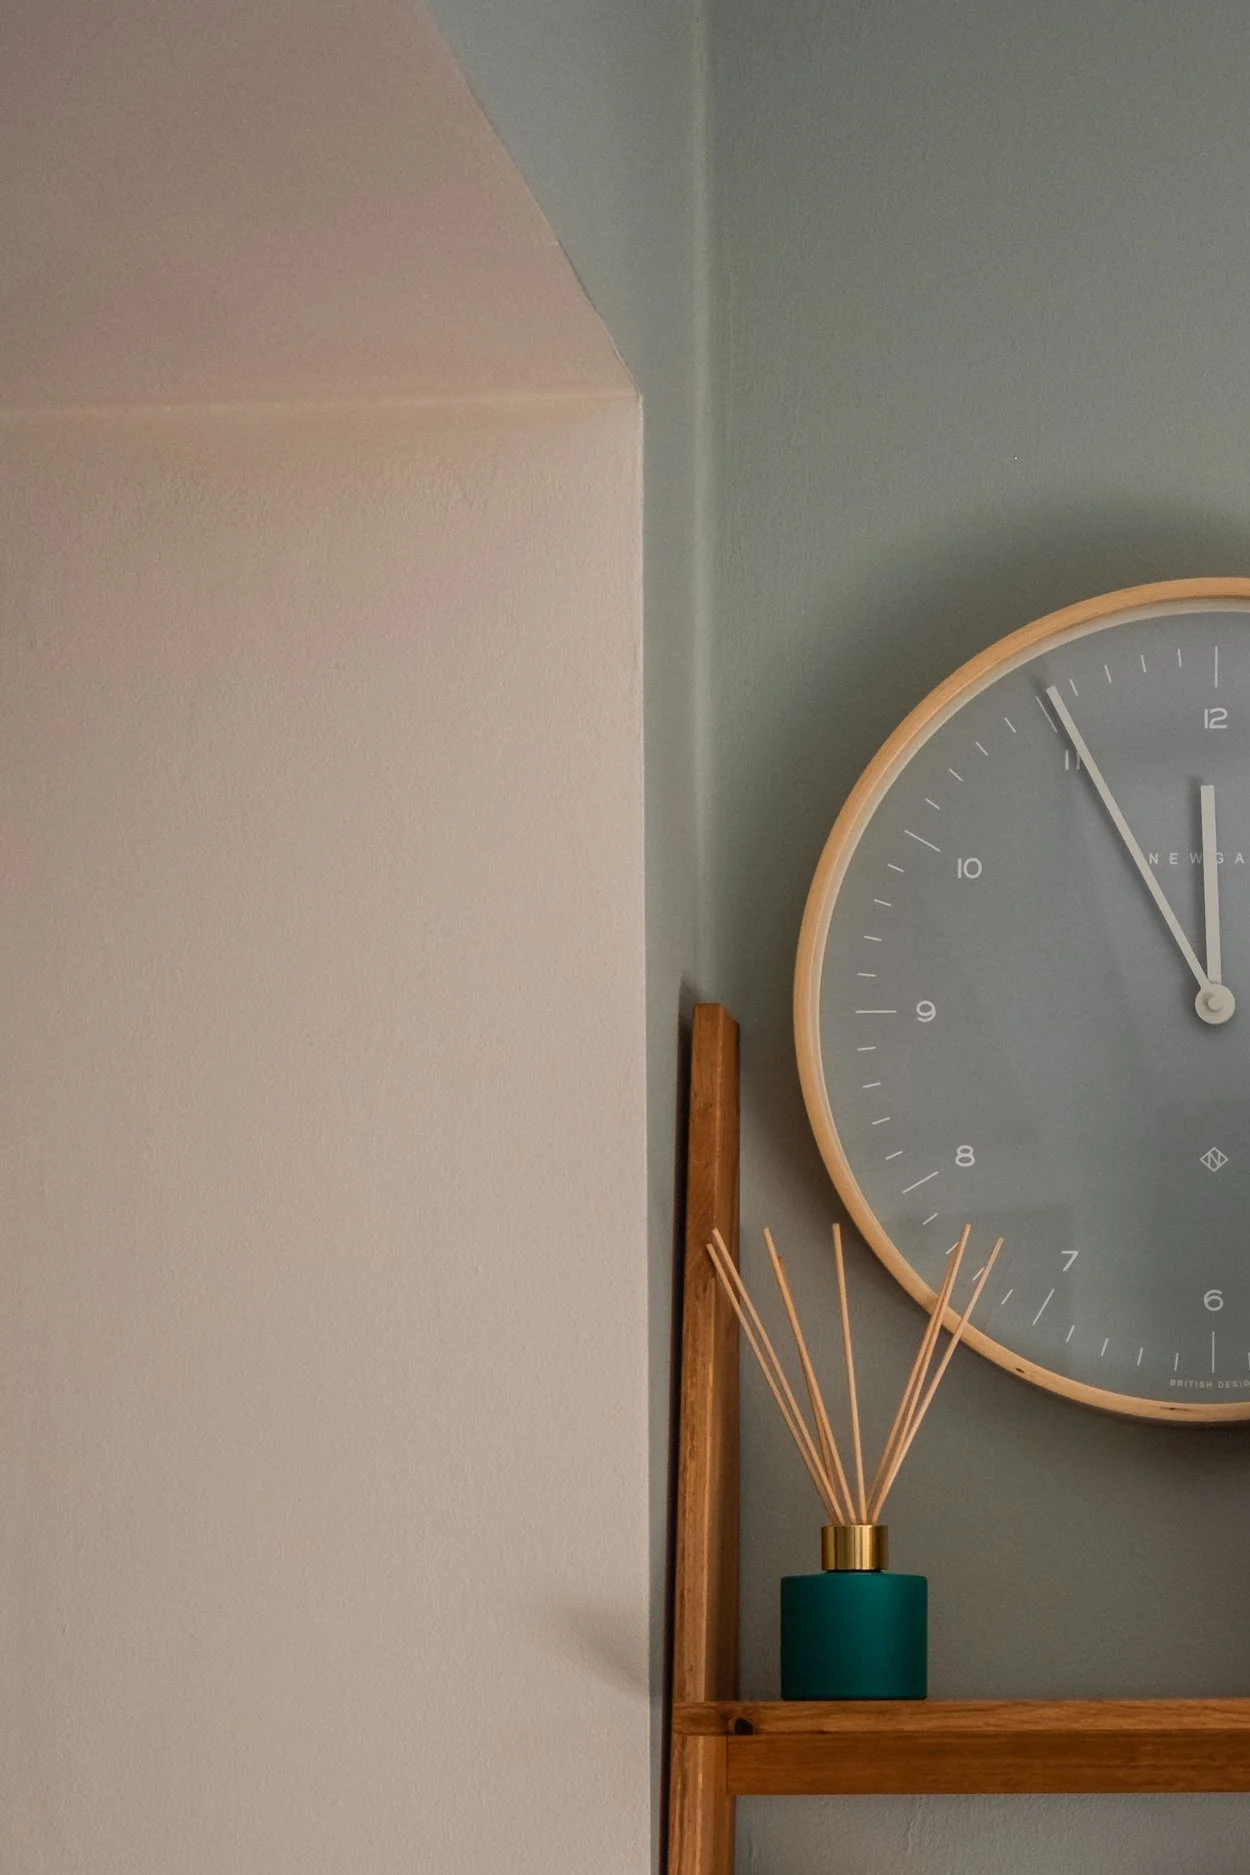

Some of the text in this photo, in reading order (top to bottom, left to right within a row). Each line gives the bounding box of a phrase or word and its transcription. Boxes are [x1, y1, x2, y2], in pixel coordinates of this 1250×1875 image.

[1204, 707, 1228, 729] 12
[957, 857, 983, 879] 10
[916, 1000, 936, 1022] 9
[955, 1144, 975, 1167] 8
[1061, 1250, 1079, 1272] 7
[1203, 1289, 1224, 1311] 6
[1169, 1379, 1213, 1388] BRITISH
